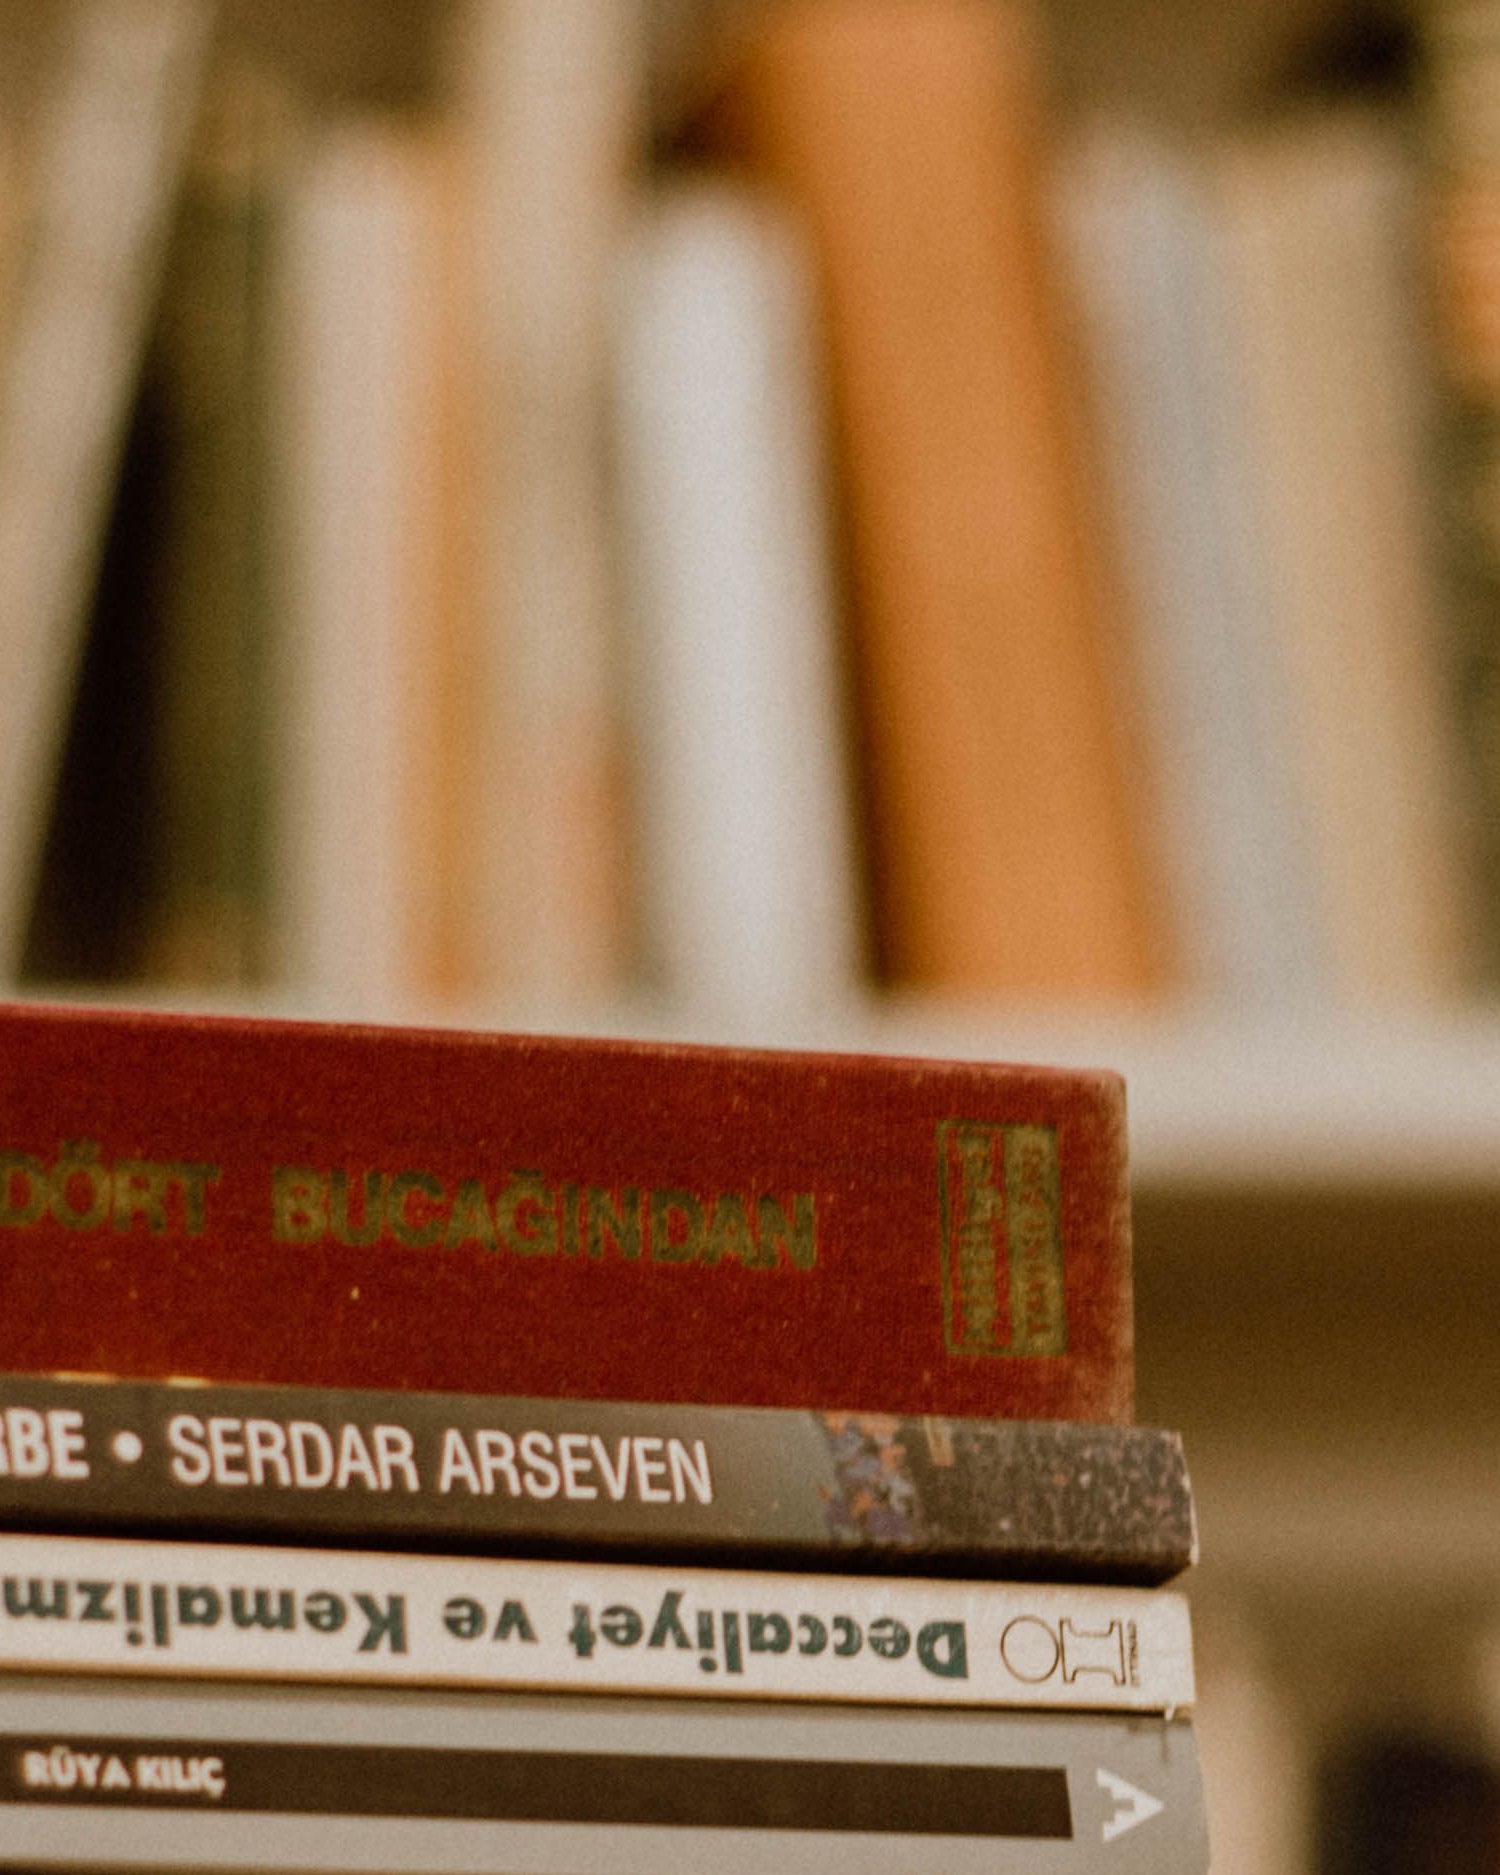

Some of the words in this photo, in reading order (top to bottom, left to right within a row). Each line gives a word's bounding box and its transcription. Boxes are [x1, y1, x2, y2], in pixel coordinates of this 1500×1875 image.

[272, 1166, 817, 1270] BUCAĞINDAN
[167, 1415, 419, 1491] SERDAR
[439, 1429, 712, 1505] ARSEVEN
[2, 1575, 408, 1656] Kemalizm
[443, 1597, 536, 1642] ve
[569, 1591, 968, 1680] Deccaliyet
[23, 1747, 130, 1787] RÜYA
[136, 1757, 224, 1796] KILIÇ
